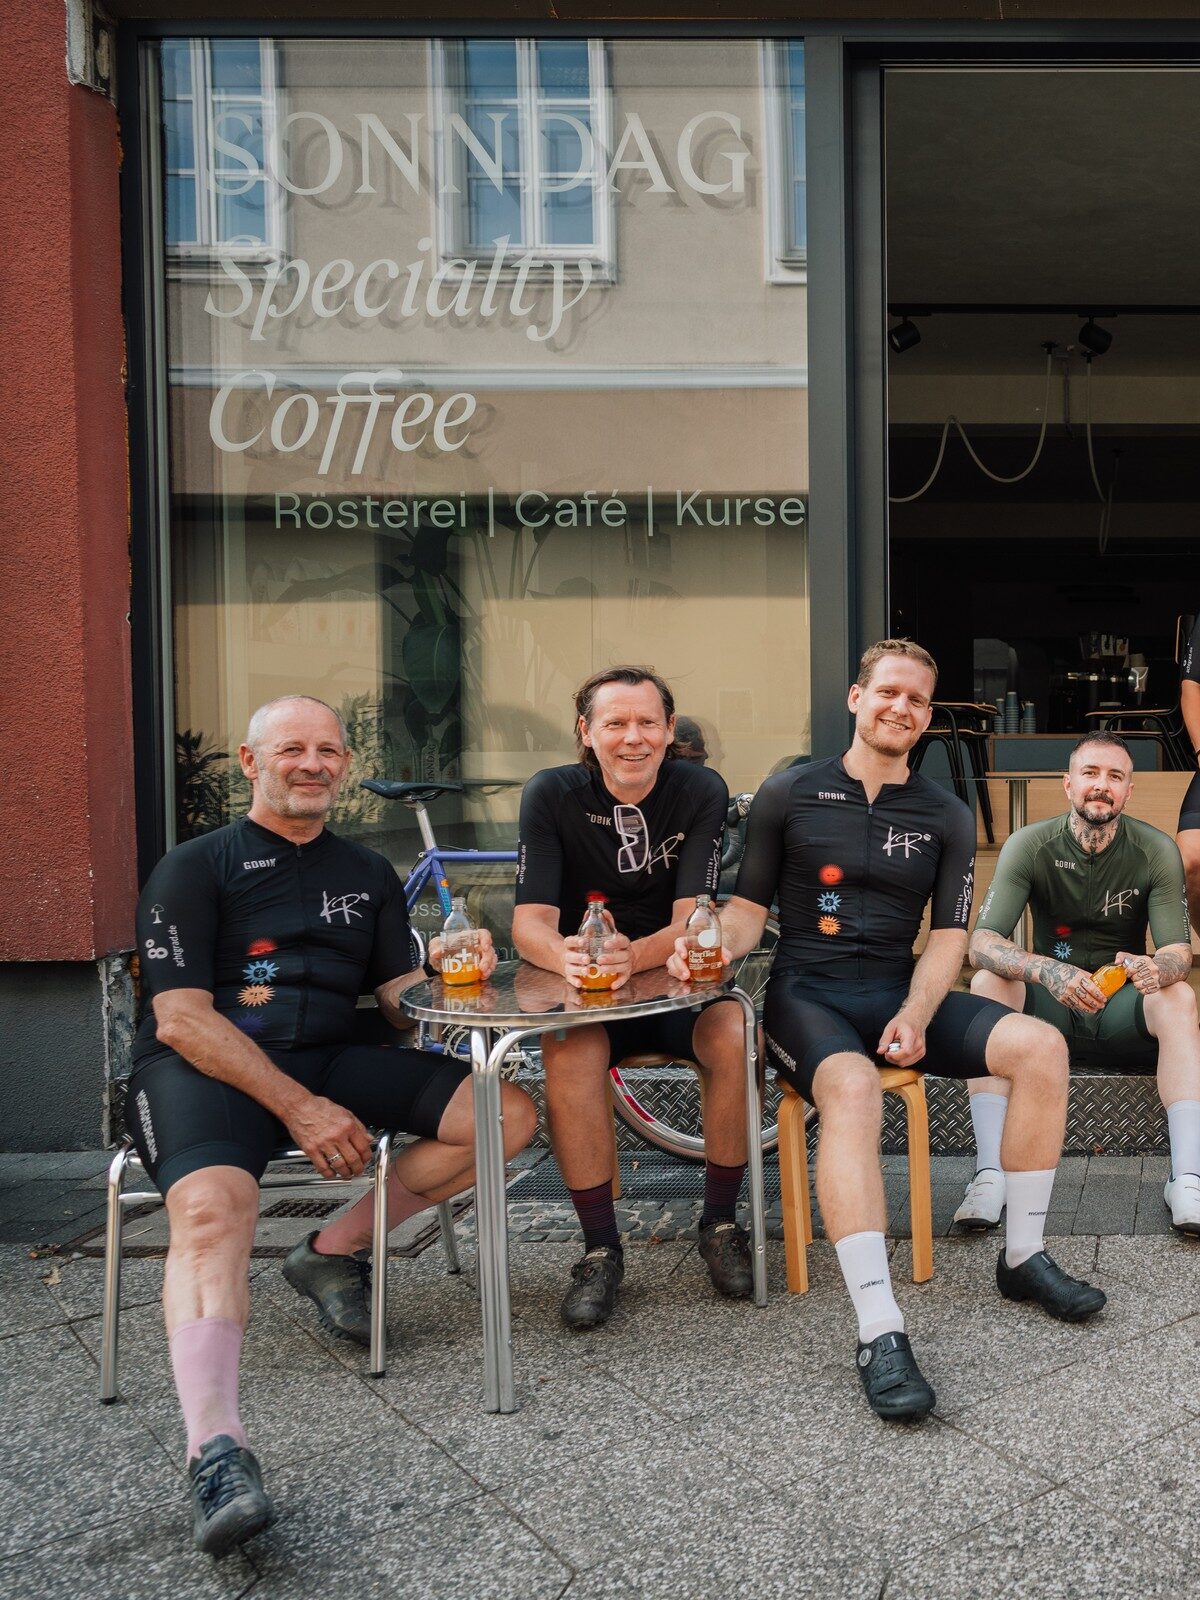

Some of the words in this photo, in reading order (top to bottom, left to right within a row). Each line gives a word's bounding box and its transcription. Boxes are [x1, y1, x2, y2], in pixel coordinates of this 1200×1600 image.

[204, 110, 752, 197] SONNDAG
[203, 233, 593, 342] Specialty
[208, 369, 477, 475] Coffee
[274, 489, 467, 529] Rösterei
[515, 487, 628, 529] Café
[676, 488, 806, 528] Kurse
[585, 812, 613, 827] OBIK
[168, 924, 186, 968] achtgrad.de
